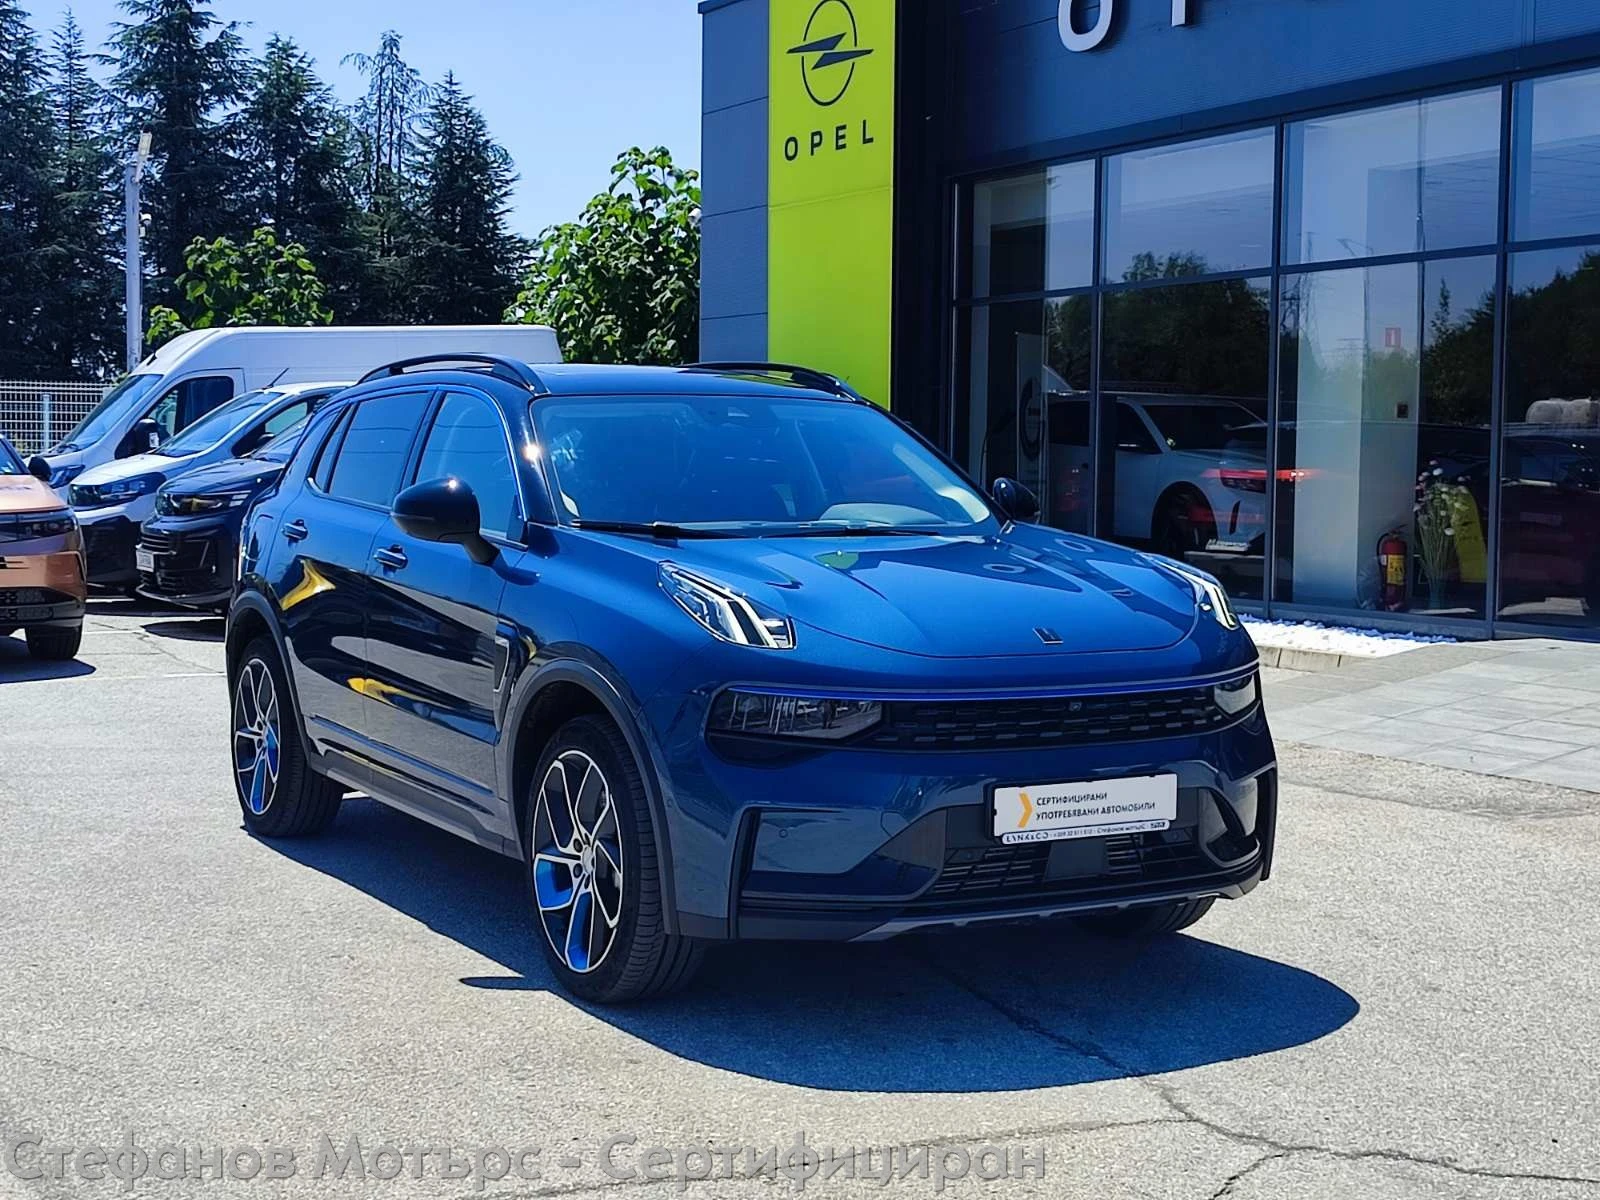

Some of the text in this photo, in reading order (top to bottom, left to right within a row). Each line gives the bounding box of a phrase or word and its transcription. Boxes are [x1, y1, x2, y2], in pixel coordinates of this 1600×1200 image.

[784, 119, 874, 162] OPEL
[1036, 792, 1107, 806] СЕРТИФИЦИРАНИ
[1036, 802, 1155, 820] УПОТРЕБЯВАНИ АВТОМОБИЛИ
